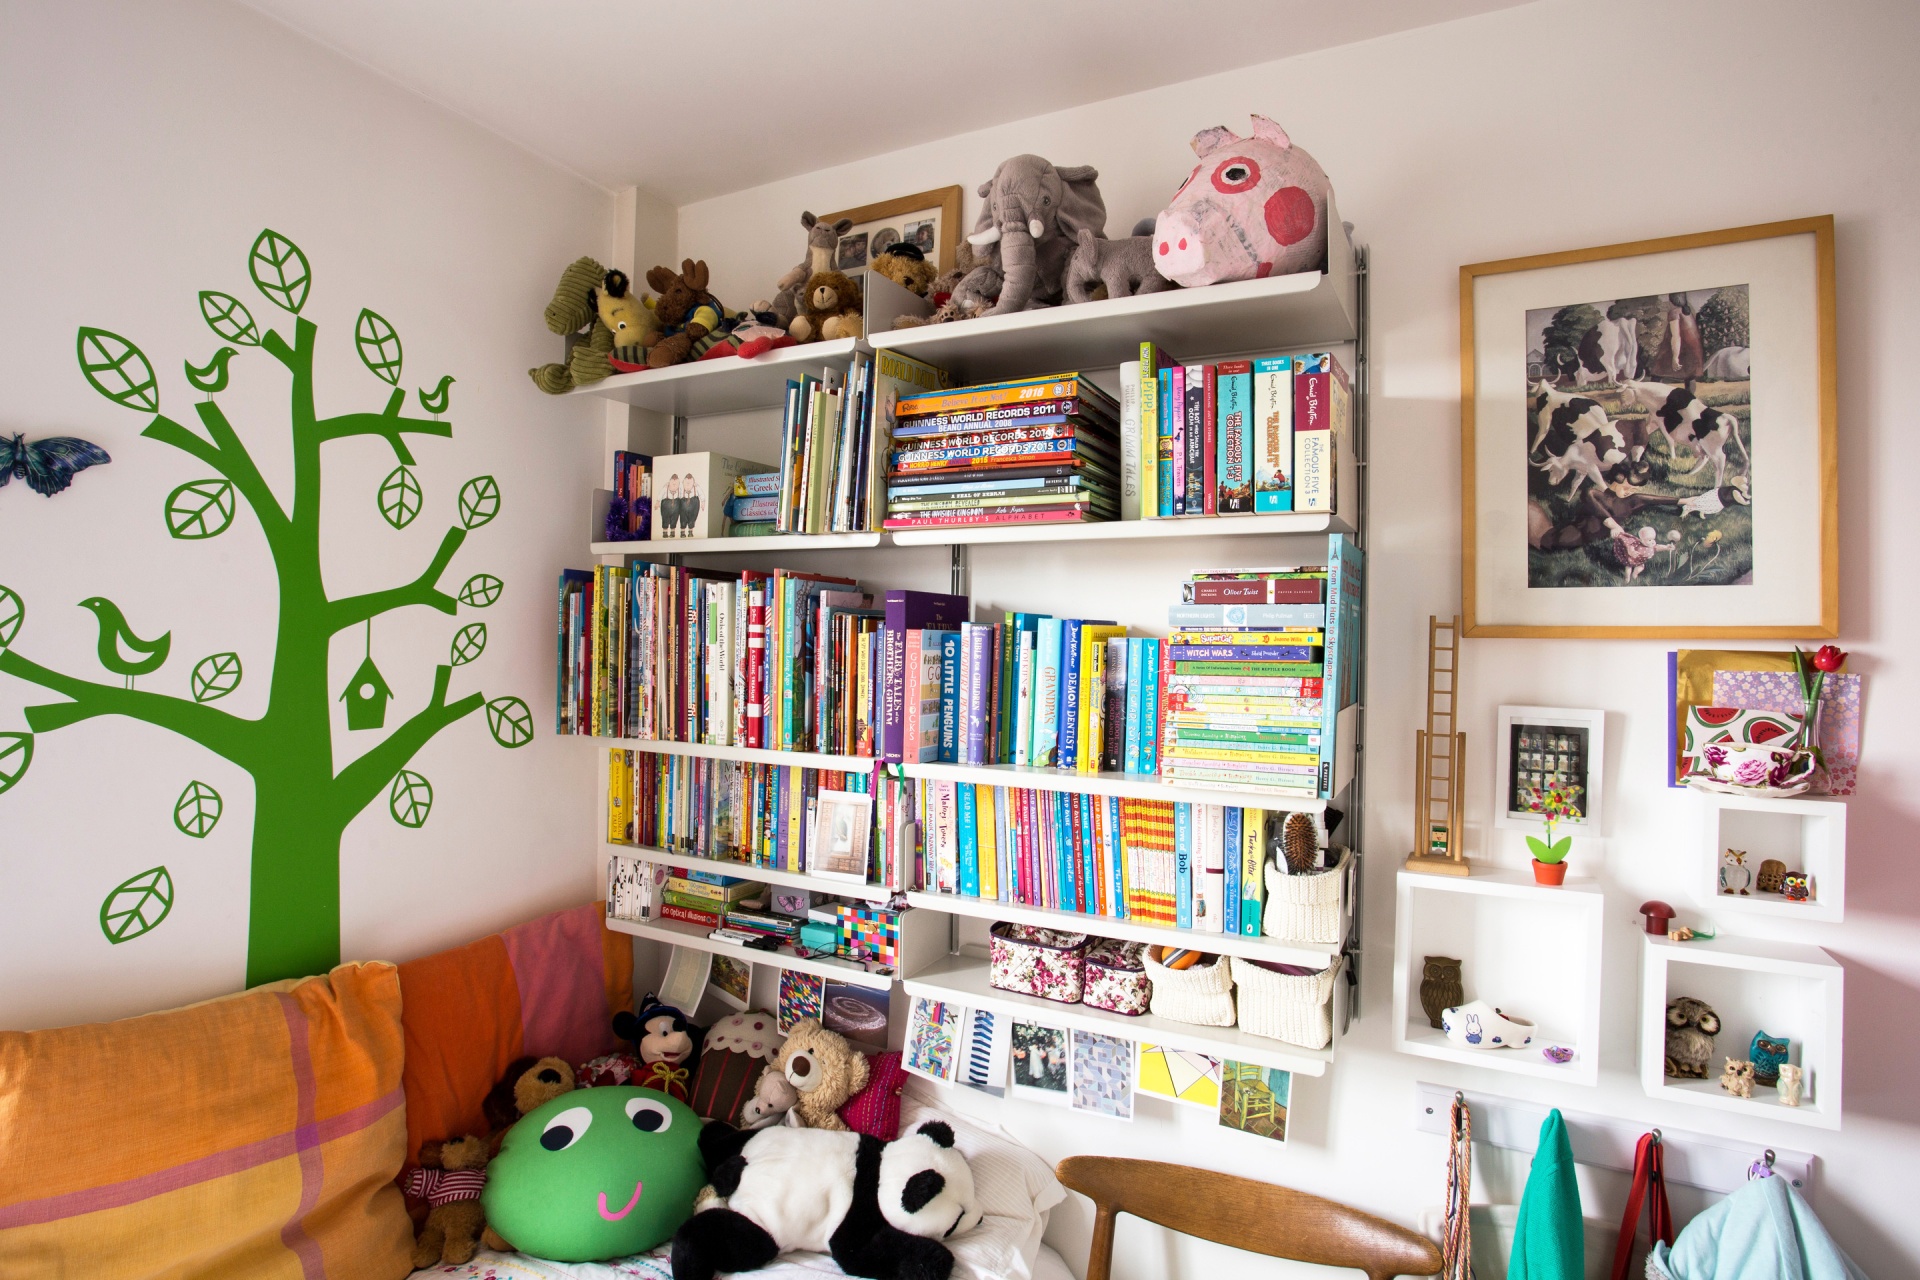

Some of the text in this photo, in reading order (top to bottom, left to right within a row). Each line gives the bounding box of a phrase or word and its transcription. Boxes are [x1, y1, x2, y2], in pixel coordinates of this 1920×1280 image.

[881, 355, 913, 383] ROALD
[1019, 387, 1044, 399] 2016
[1305, 378, 1318, 425] Enid Blyton
[903, 405, 1056, 428] GUINNESS WORLD RECORDS 2011
[938, 419, 1012, 432] BEANO ANNUAL 2008
[898, 441, 1054, 461] GUINNESS WORLD RECORDS 2015
[901, 438, 947, 451] GUINNESS
[948, 435, 980, 447] WORLD
[982, 430, 1028, 445] RECORDS
[1234, 411, 1242, 482] THE FAMOUS FIVE
[910, 461, 929, 469] HORRID
[991, 454, 1017, 463] Francesca
[1125, 419, 1136, 497] GRIMM TALES
[1311, 438, 1319, 473] FAMOUS
[740, 508, 766, 516] Classics
[920, 508, 984, 519] THE INVISIBLE KINGDOM
[938, 515, 989, 523] THURLBY'S
[995, 513, 1045, 521] ALPHABET
[1223, 587, 1259, 596] Oliver Twist
[719, 628, 725, 638] of
[1329, 626, 1335, 634] to
[878, 640, 882, 650] AM
[974, 637, 982, 659] BIBLE
[1187, 649, 1233, 657] WITCH WARS
[784, 655, 792, 671] Long
[886, 630, 895, 687] BROTHERS
[894, 641, 903, 675] FAIRY
[1326, 637, 1336, 680] Skyscrapers
[960, 650, 969, 693] POPPER'S
[894, 678, 902, 711] TALES
[909, 652, 918, 740] GOLDILOCKS
[943, 640, 955, 748] 10 LITTLE PENGUINS
[972, 673, 981, 711] CHILDREN
[1044, 666, 1056, 724] GRANDPA'S
[959, 697, 968, 745] PENGUINS
[1066, 672, 1077, 751] DEMON DENTIST
[1145, 684, 1154, 736] RATBURGER
[940, 794, 950, 818] Malory
[1179, 843, 1186, 851] of
[1178, 853, 1188, 874] Bob
[670, 908, 687, 919] Optical
[687, 909, 706, 922] illusions
